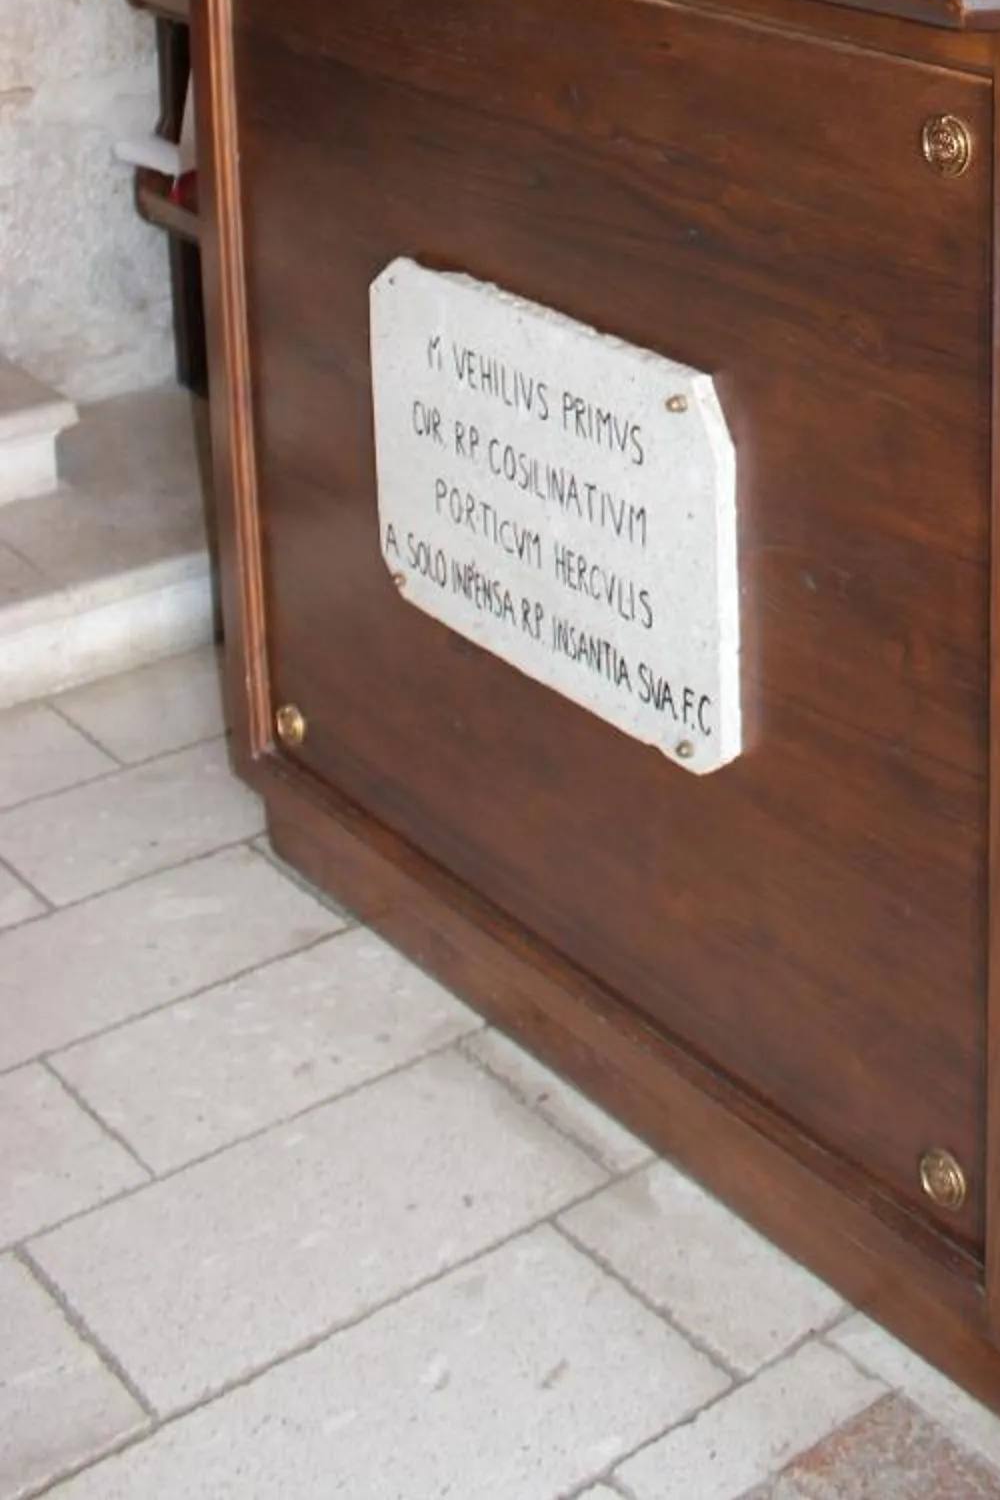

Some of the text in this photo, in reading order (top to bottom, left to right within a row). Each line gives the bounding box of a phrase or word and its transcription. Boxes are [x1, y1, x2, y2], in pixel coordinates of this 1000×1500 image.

[453, 342, 549, 421] VEHILIVS
[562, 390, 645, 465] PRIMVS
[488, 438, 647, 547] COSILINATIVM
[407, 532, 448, 589] SOLO
[434, 477, 653, 628] PORTICVM HERCVLIS
